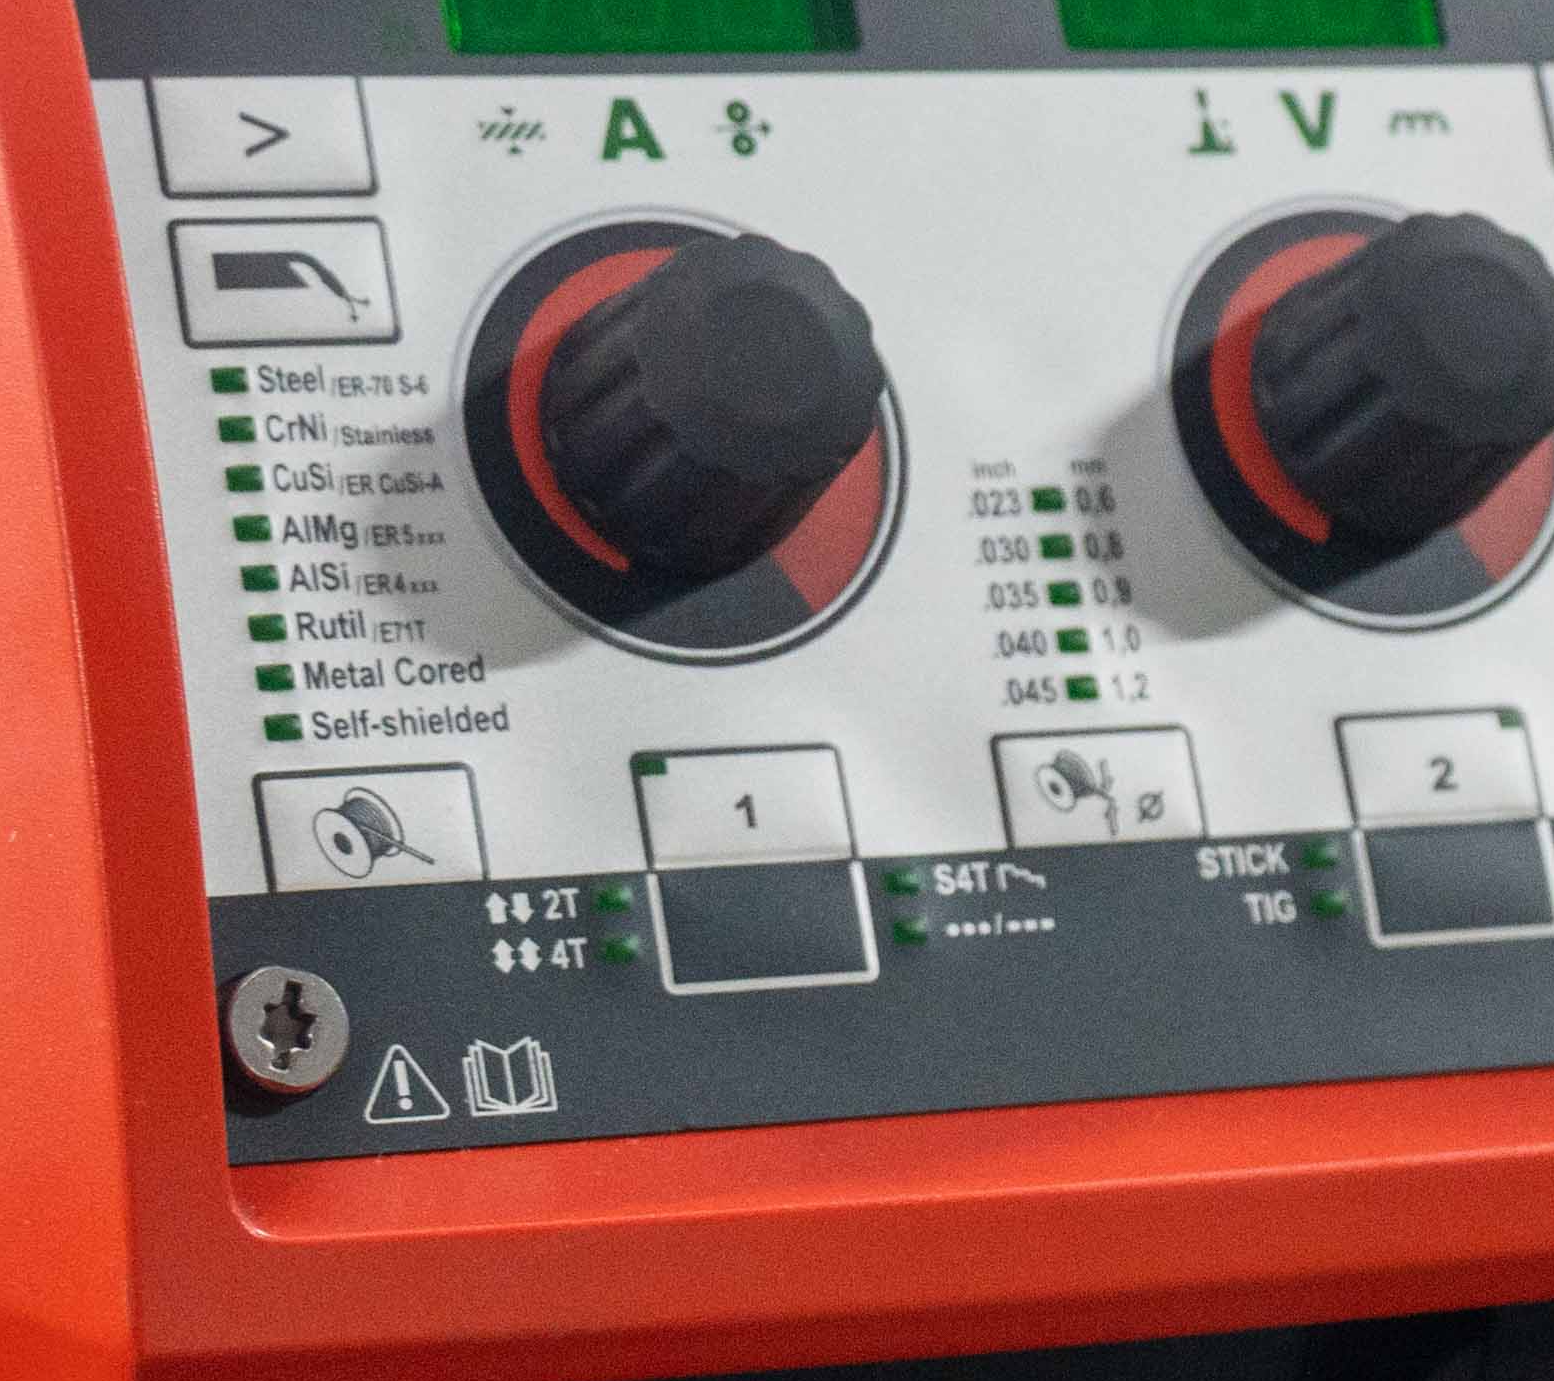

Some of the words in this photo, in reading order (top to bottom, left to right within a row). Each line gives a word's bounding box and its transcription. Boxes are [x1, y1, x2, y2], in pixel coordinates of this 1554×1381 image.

[602, 96, 666, 161] A
[1278, 90, 1337, 151] V
[257, 364, 326, 395] Steel
[266, 413, 329, 444] CrNi
[273, 463, 335, 494] CuSi
[282, 514, 358, 550] AlMg
[290, 561, 350, 593] AlSi
[295, 610, 366, 641] Rutil
[303, 659, 385, 691] Metal
[395, 652, 486, 687] Cored
[313, 701, 510, 741] Self-shielded
[1430, 756, 1459, 792] 2
[734, 794, 758, 829] 1
[1196, 842, 1289, 880] STICK
[543, 888, 580, 921] 2T
[1243, 890, 1297, 924] TIG
[550, 937, 588, 970] 4T
